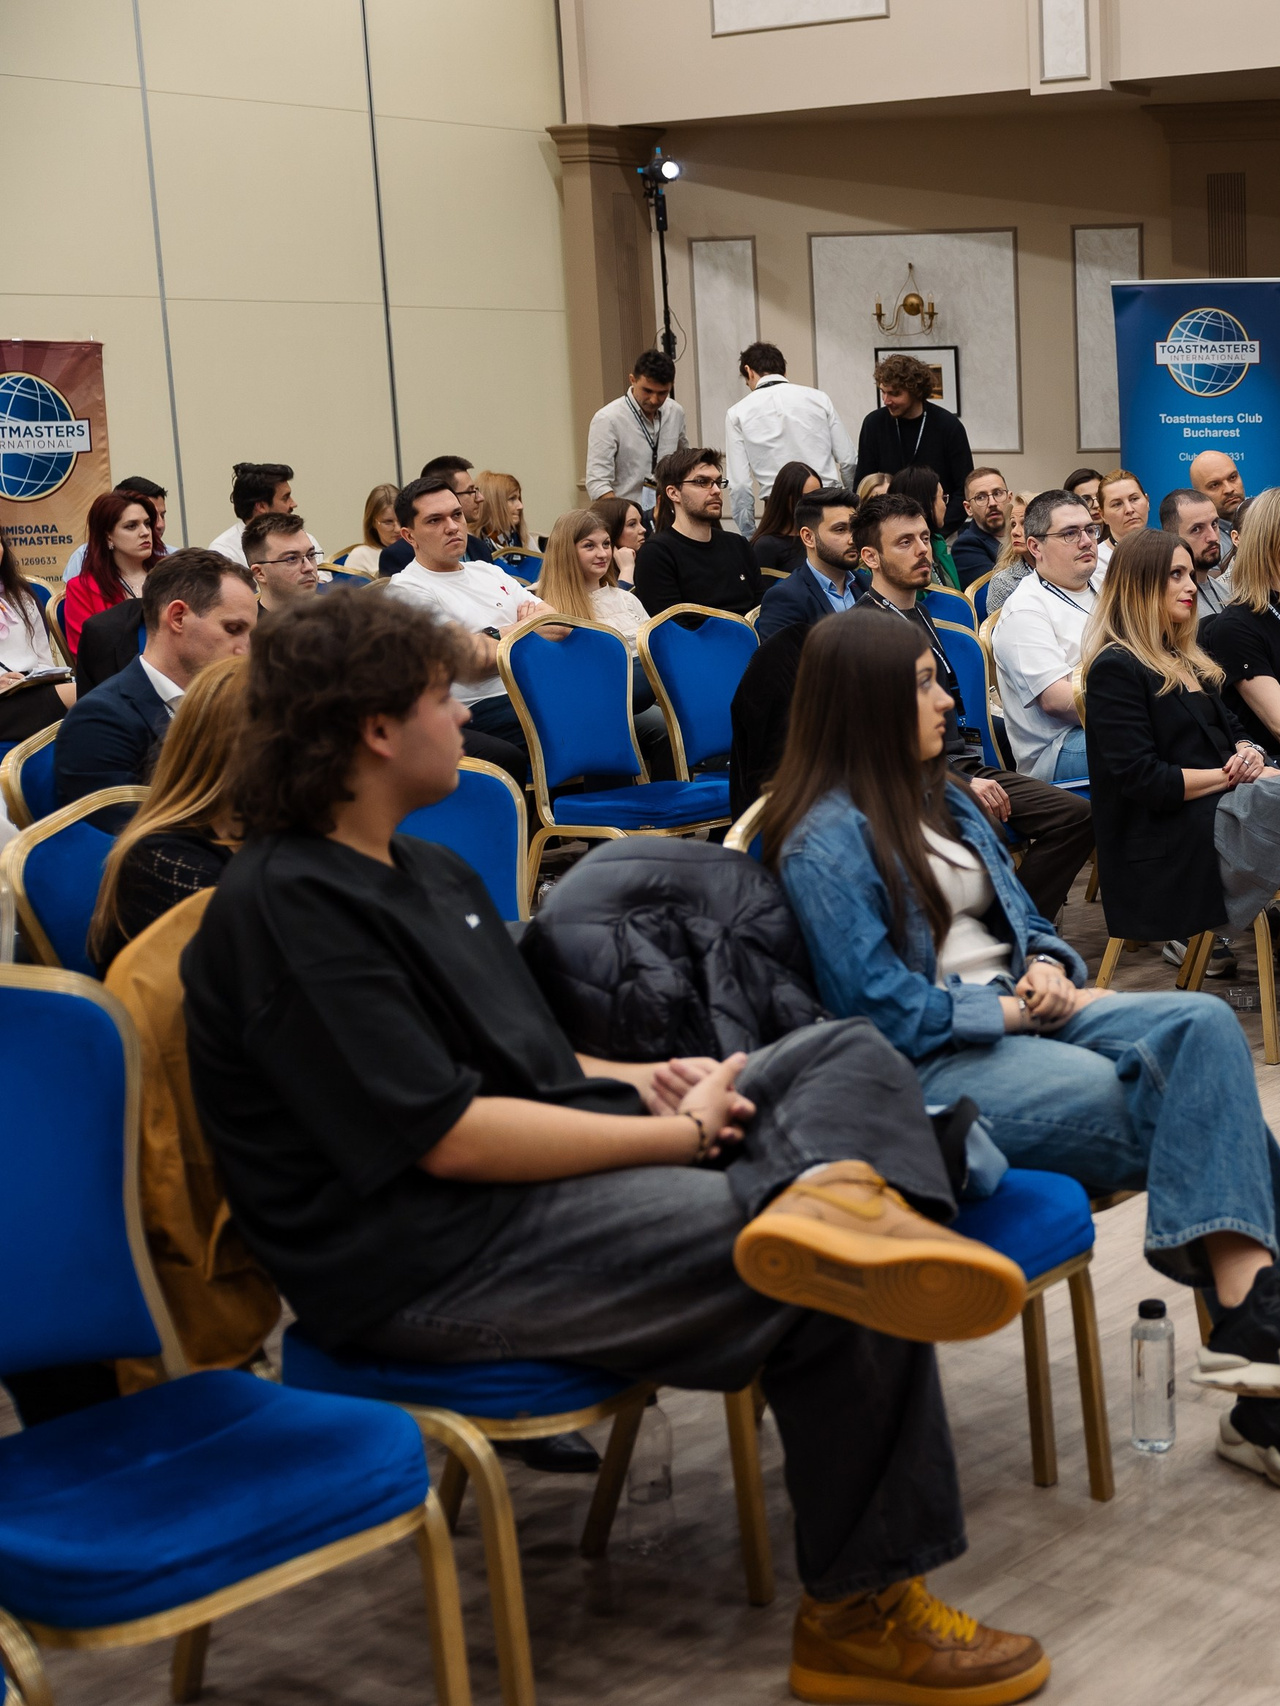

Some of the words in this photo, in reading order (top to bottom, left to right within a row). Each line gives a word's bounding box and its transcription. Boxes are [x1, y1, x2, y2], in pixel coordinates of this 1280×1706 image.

[1159, 344, 1256, 354] TOASTMASTERS
[1159, 413, 1234, 424] Toastmasters
[1236, 413, 1263, 424] Club
[0, 425, 85, 438] TMASTERS
[1183, 427, 1240, 438] Bucharest
[0, 440, 72, 449] RNATIONAL
[2, 524, 59, 535] IMISOARA
[5, 535, 74, 547] STMASTERS
[21, 556, 58, 566] 1269633
